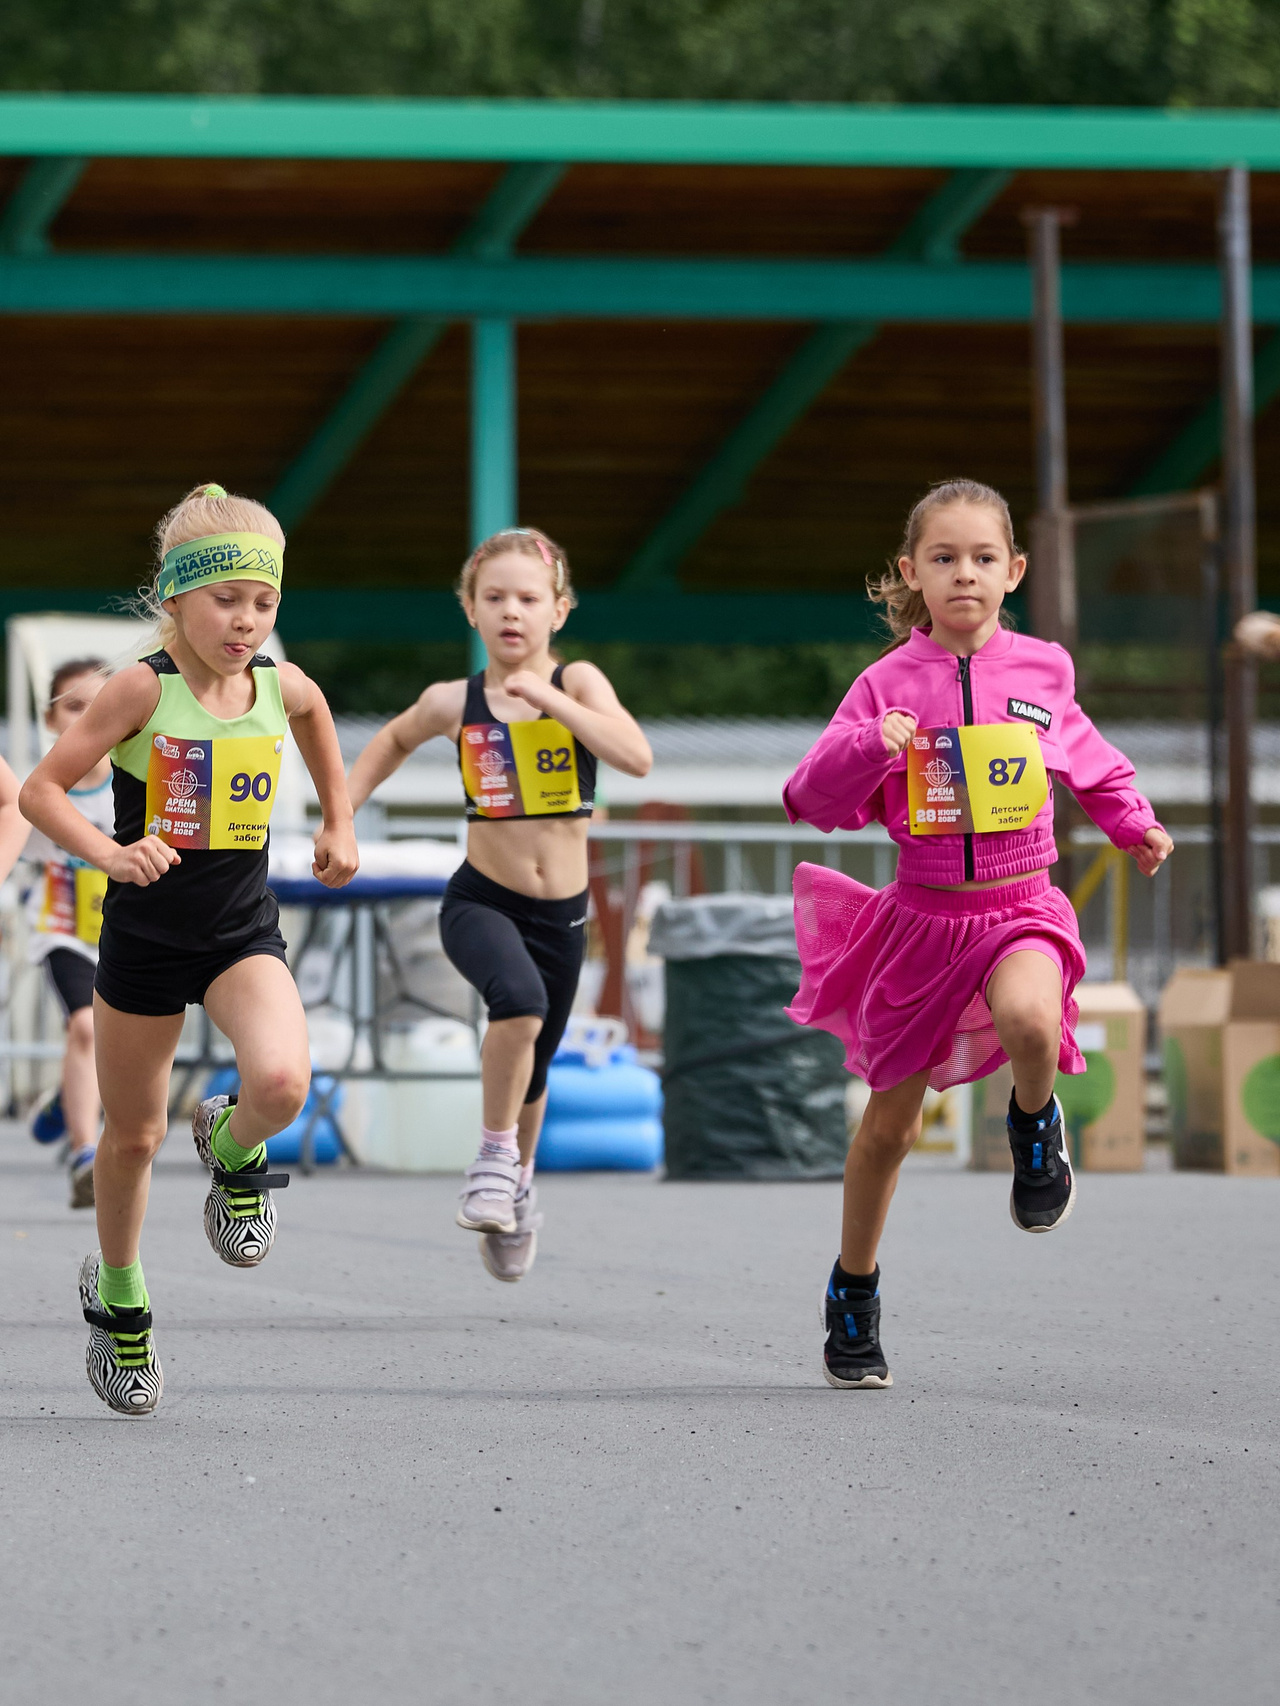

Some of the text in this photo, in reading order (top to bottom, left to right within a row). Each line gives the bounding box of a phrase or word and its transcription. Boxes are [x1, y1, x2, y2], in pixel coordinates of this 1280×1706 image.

[175, 543, 239, 565] КРОСС ТРЕЙЛ
[175, 550, 242, 577] НАБОР
[178, 562, 234, 586] ВЫСОТЫ
[1011, 700, 1051, 726] YAMMY
[537, 747, 571, 774] 82
[988, 757, 1027, 787] 87
[229, 771, 271, 803] 90
[927, 787, 955, 796] АРЕНА
[166, 797, 197, 809] АРЕНА
[991, 804, 1030, 815] Детский
[164, 806, 196, 815] БИАТЛОНА
[916, 809, 936, 823] 28
[174, 820, 201, 830] ИЮНЯ
[998, 815, 1023, 825] забег
[228, 822, 267, 832] Детский
[234, 833, 261, 842] забег
